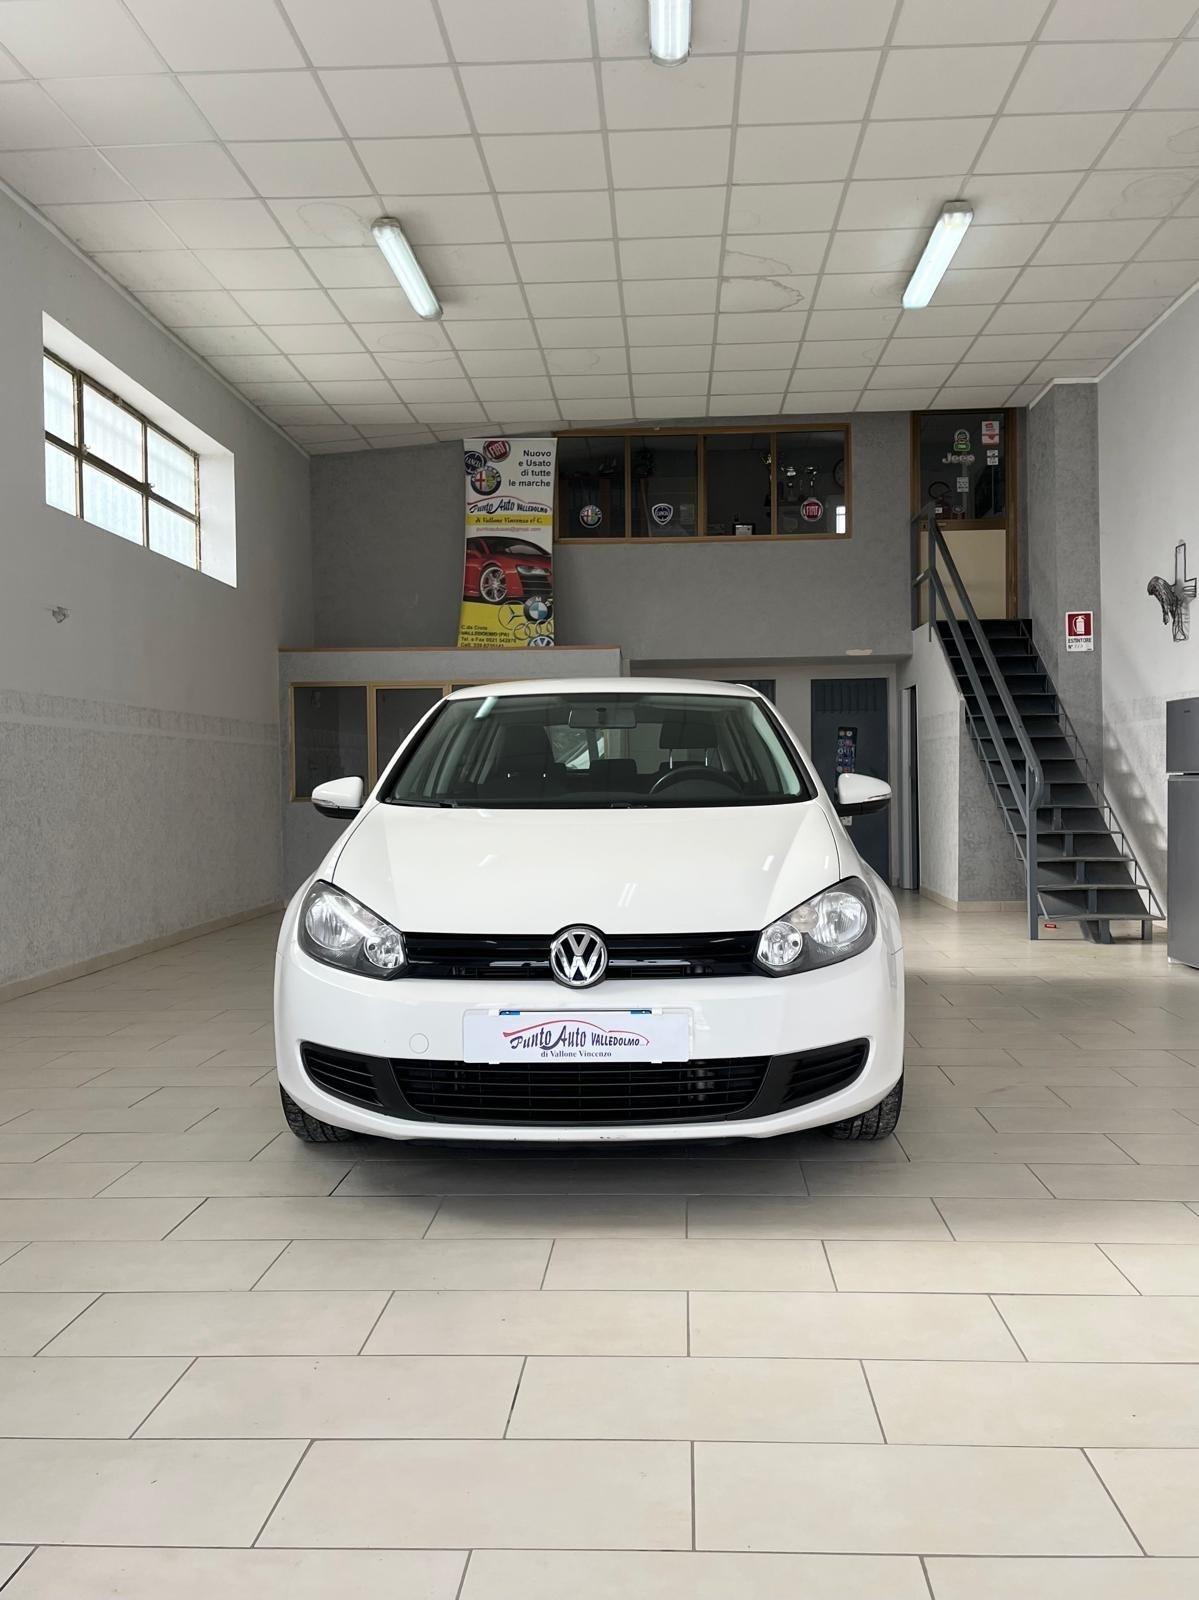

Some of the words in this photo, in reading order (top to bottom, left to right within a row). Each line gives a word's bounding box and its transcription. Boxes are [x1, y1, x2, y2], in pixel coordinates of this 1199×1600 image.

[488, 441, 506, 457] FIAT
[942, 453, 976, 465] Jeep
[469, 503, 493, 513] Punto
[487, 499, 515, 514] Auto
[517, 503, 548, 513] VALLEDOLMO
[510, 1027, 552, 1050] Punto
[540, 1025, 586, 1050] Auto
[591, 1032, 640, 1047] VALLEDOLMO
[550, 1050, 577, 1058] Vallone
[579, 1050, 612, 1058] Vincenzo
